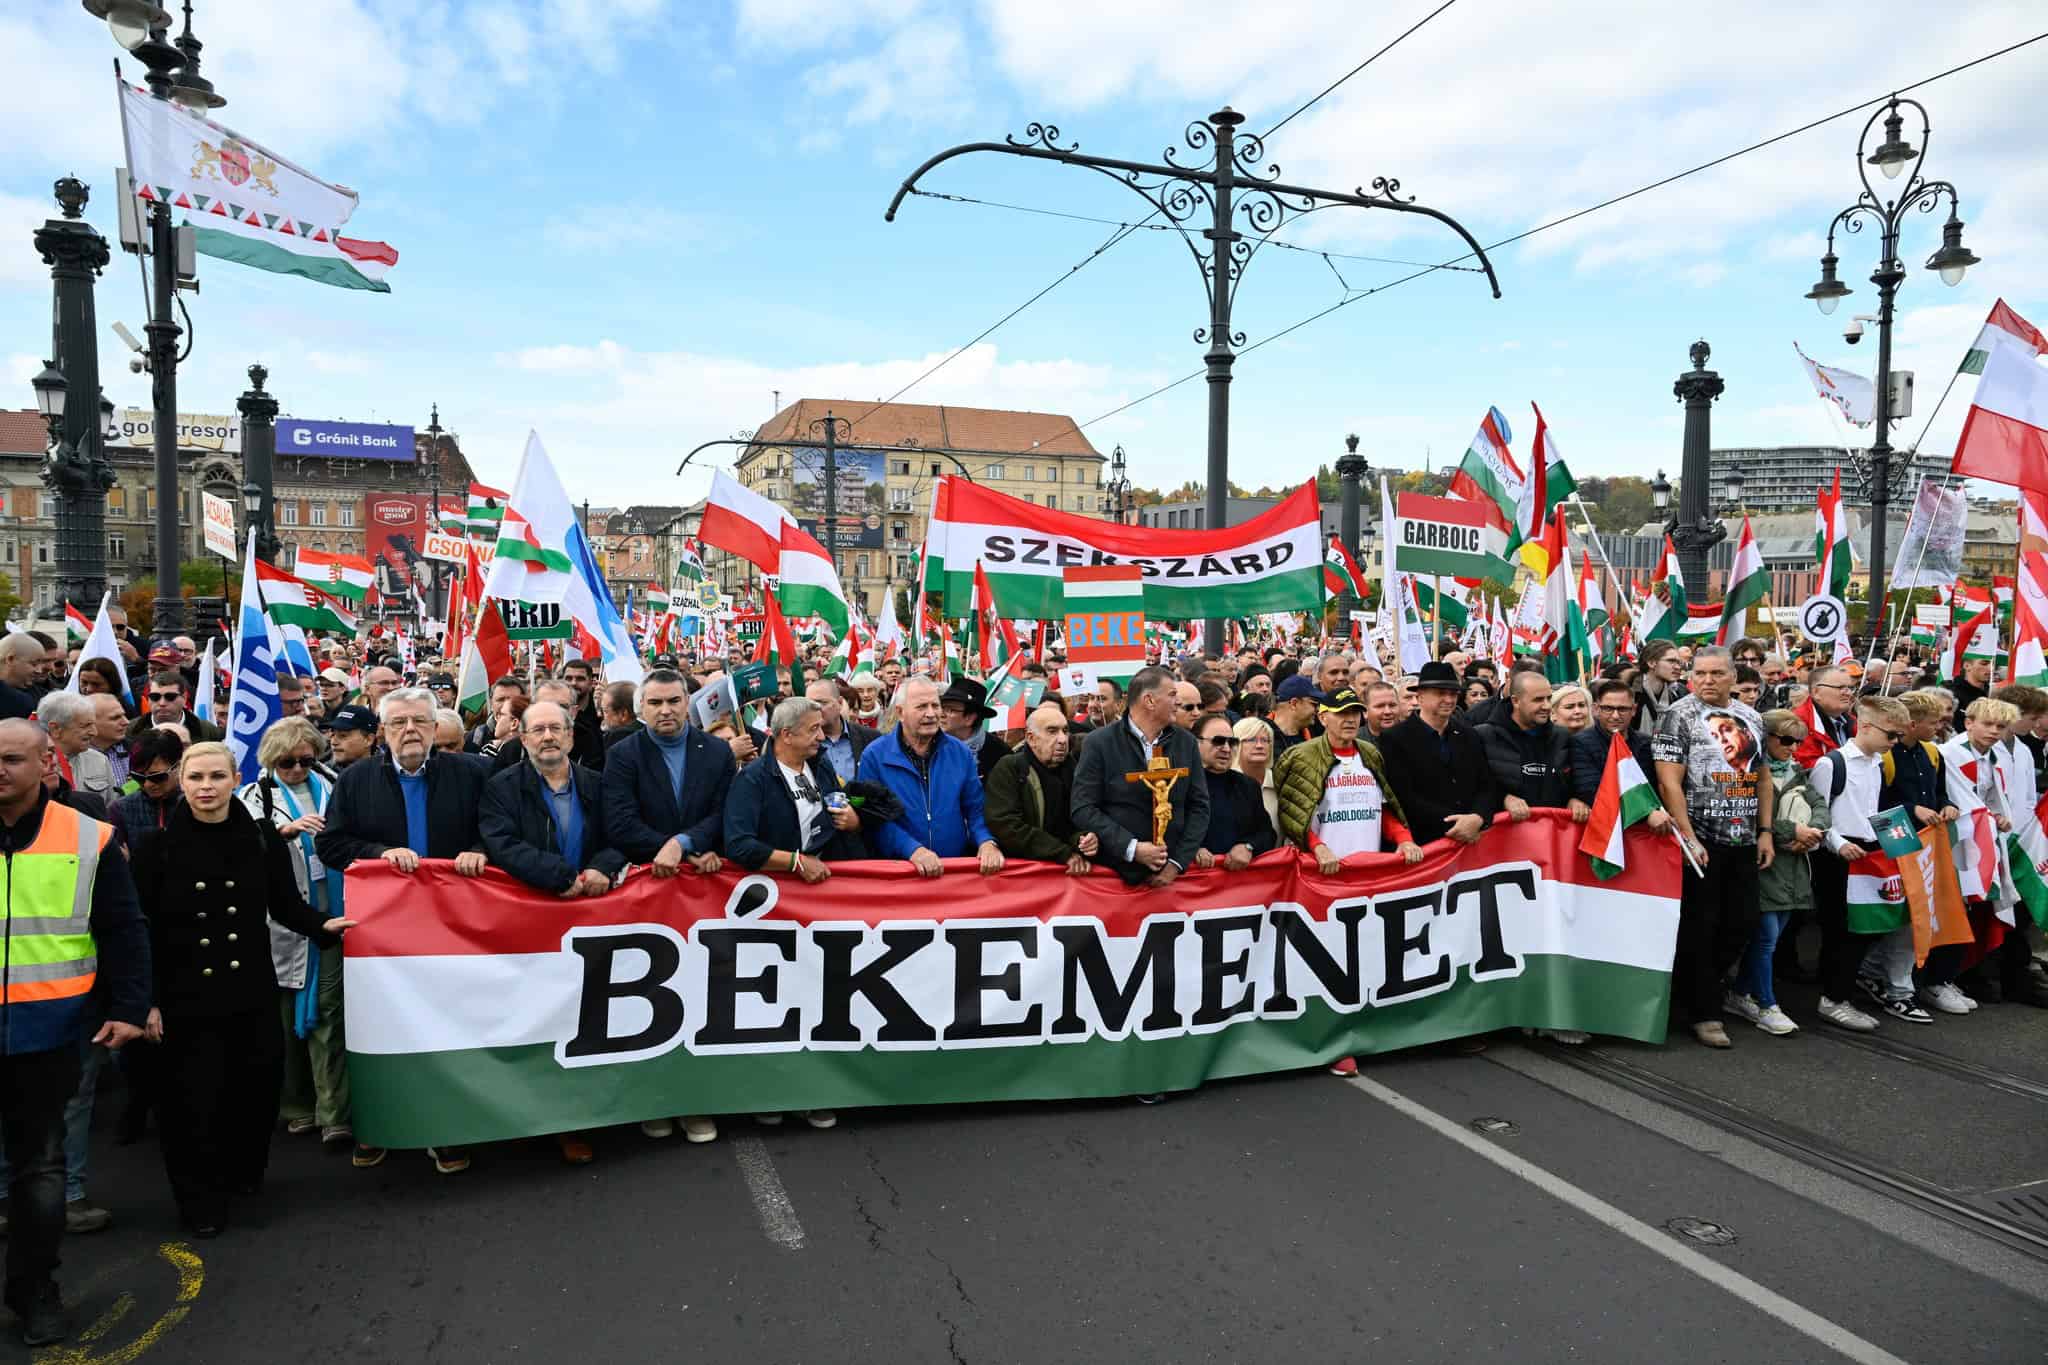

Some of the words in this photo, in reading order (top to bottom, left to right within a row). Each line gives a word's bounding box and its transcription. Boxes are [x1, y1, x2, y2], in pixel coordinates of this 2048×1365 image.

[123, 421, 238, 440] goltresor
[316, 432, 359, 447] Gránit
[362, 434, 398, 448] Bank
[428, 537, 495, 562] CSONA
[1404, 520, 1479, 552] GARBOLC
[984, 535, 1294, 578] SZEKSZÁRD
[1069, 614, 1140, 647] BEKE
[562, 867, 1539, 1060] BÉKEMENET
